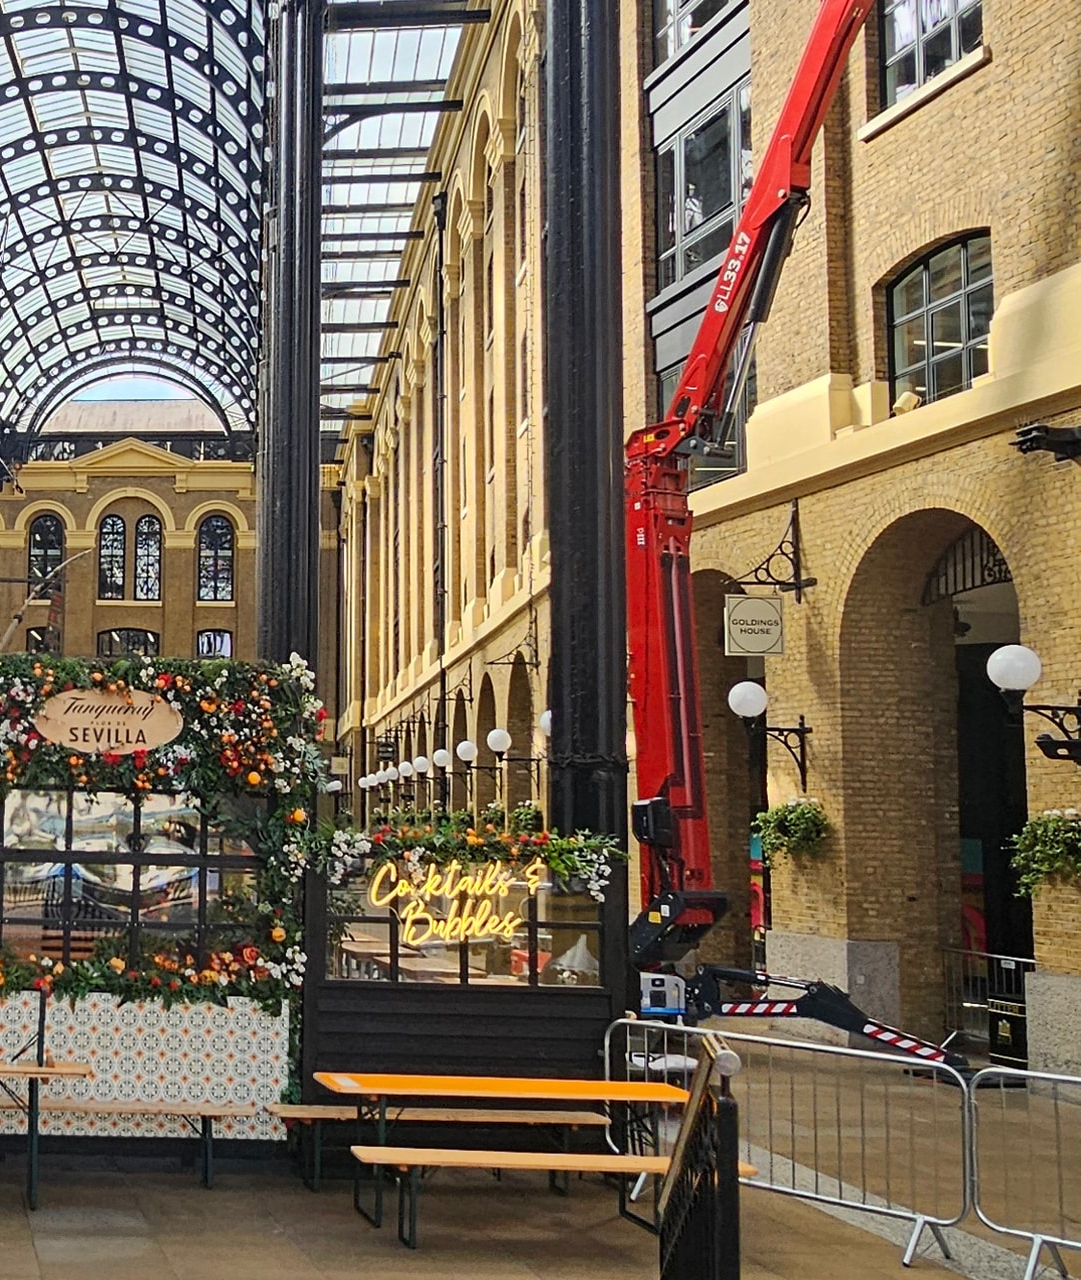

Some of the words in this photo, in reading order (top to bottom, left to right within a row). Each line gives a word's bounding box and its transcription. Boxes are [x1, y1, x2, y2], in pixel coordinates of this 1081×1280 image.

[716, 231, 751, 300] LL33.17
[731, 618, 780, 627] GOLDINGS
[63, 696, 155, 721] Tanqueray
[69, 727, 147, 744] SEVILLA
[525, 856, 547, 895] &
[400, 899, 523, 946] Bubbles
